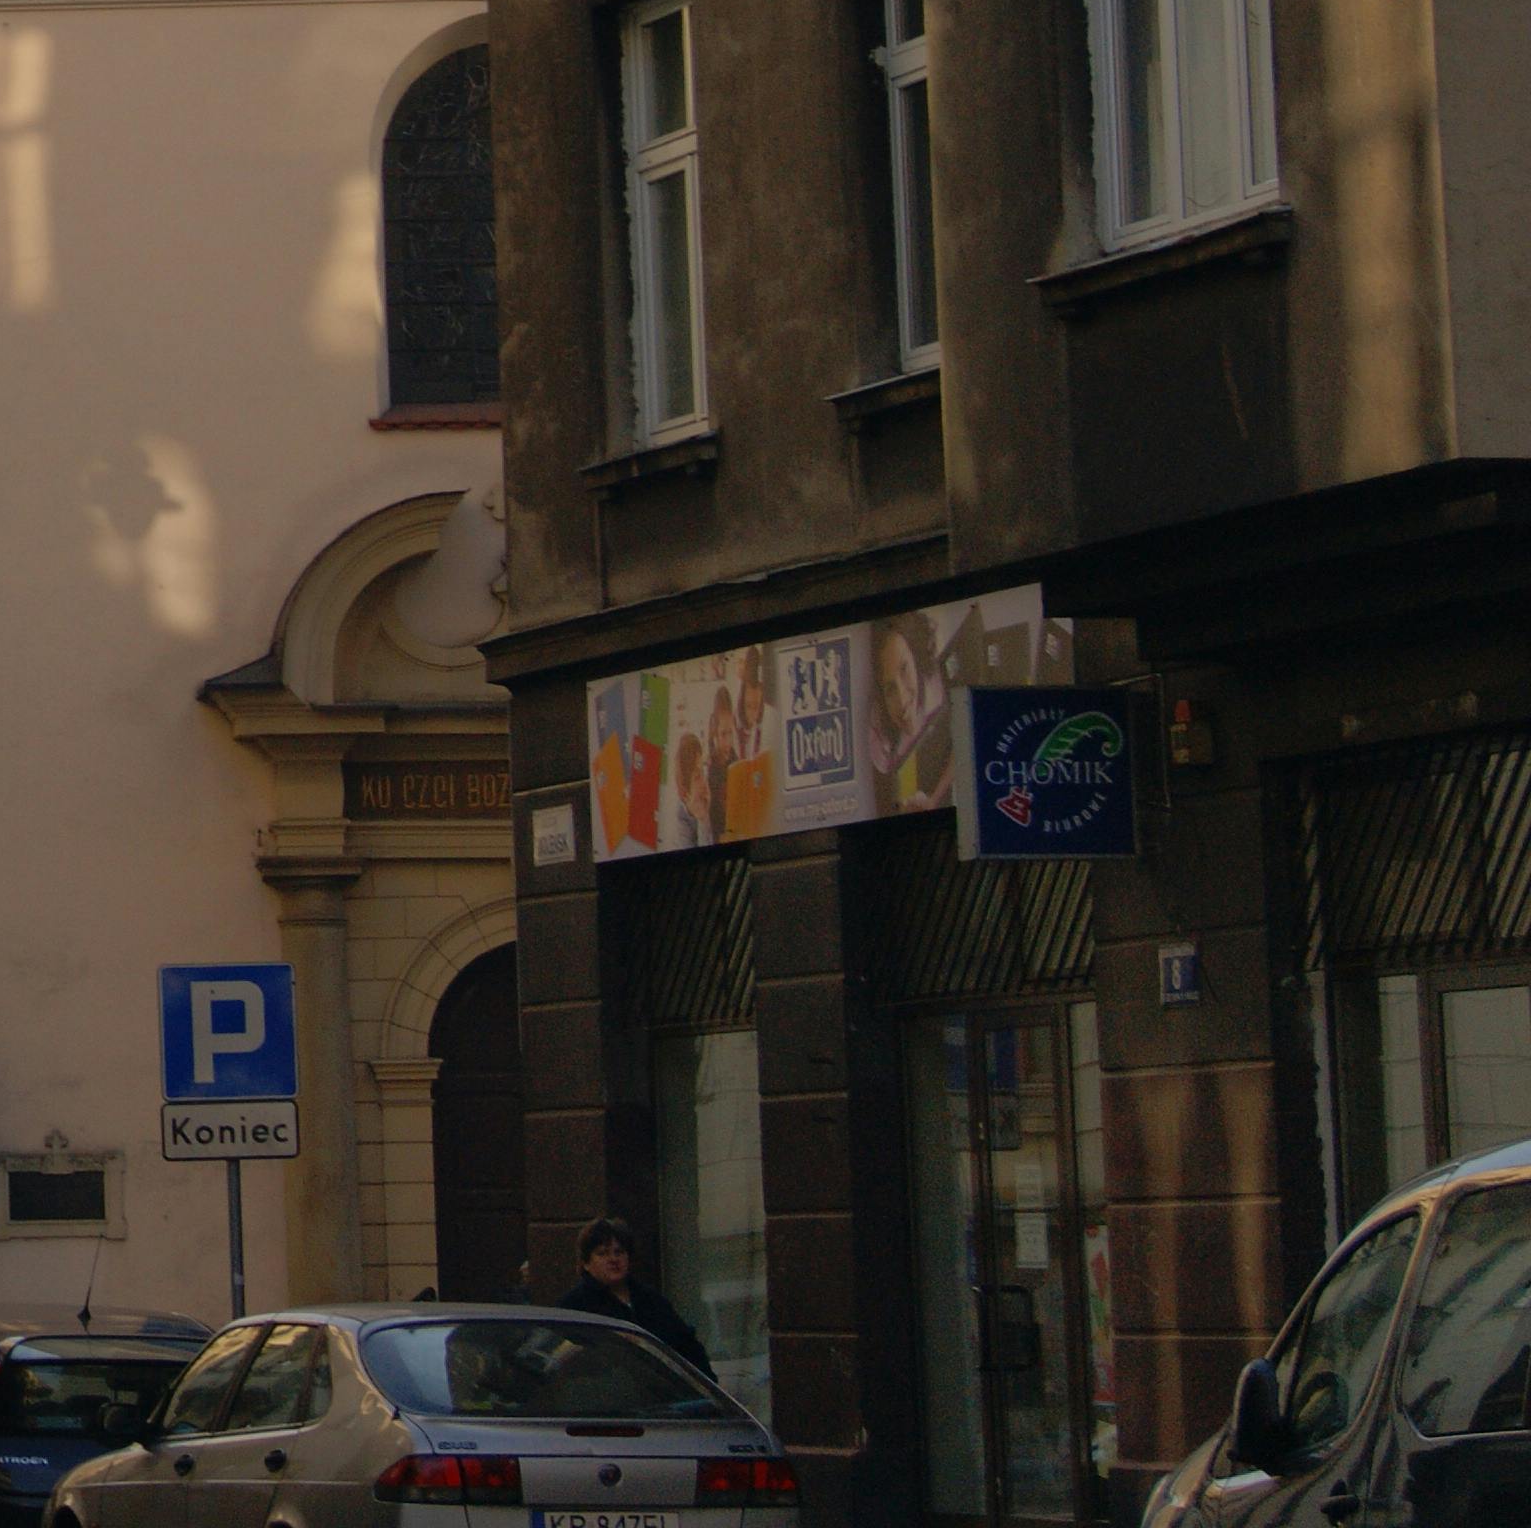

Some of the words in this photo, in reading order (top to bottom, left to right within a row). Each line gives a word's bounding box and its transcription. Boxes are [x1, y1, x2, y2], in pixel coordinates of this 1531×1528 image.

[792, 716, 844, 771] Oxford
[403, 773, 456, 809] CZCI
[984, 759, 1114, 786] CHOMIK
[1043, 792, 1107, 833] BIUROWE
[190, 980, 266, 1084] P
[171, 1117, 290, 1146] Koniec
